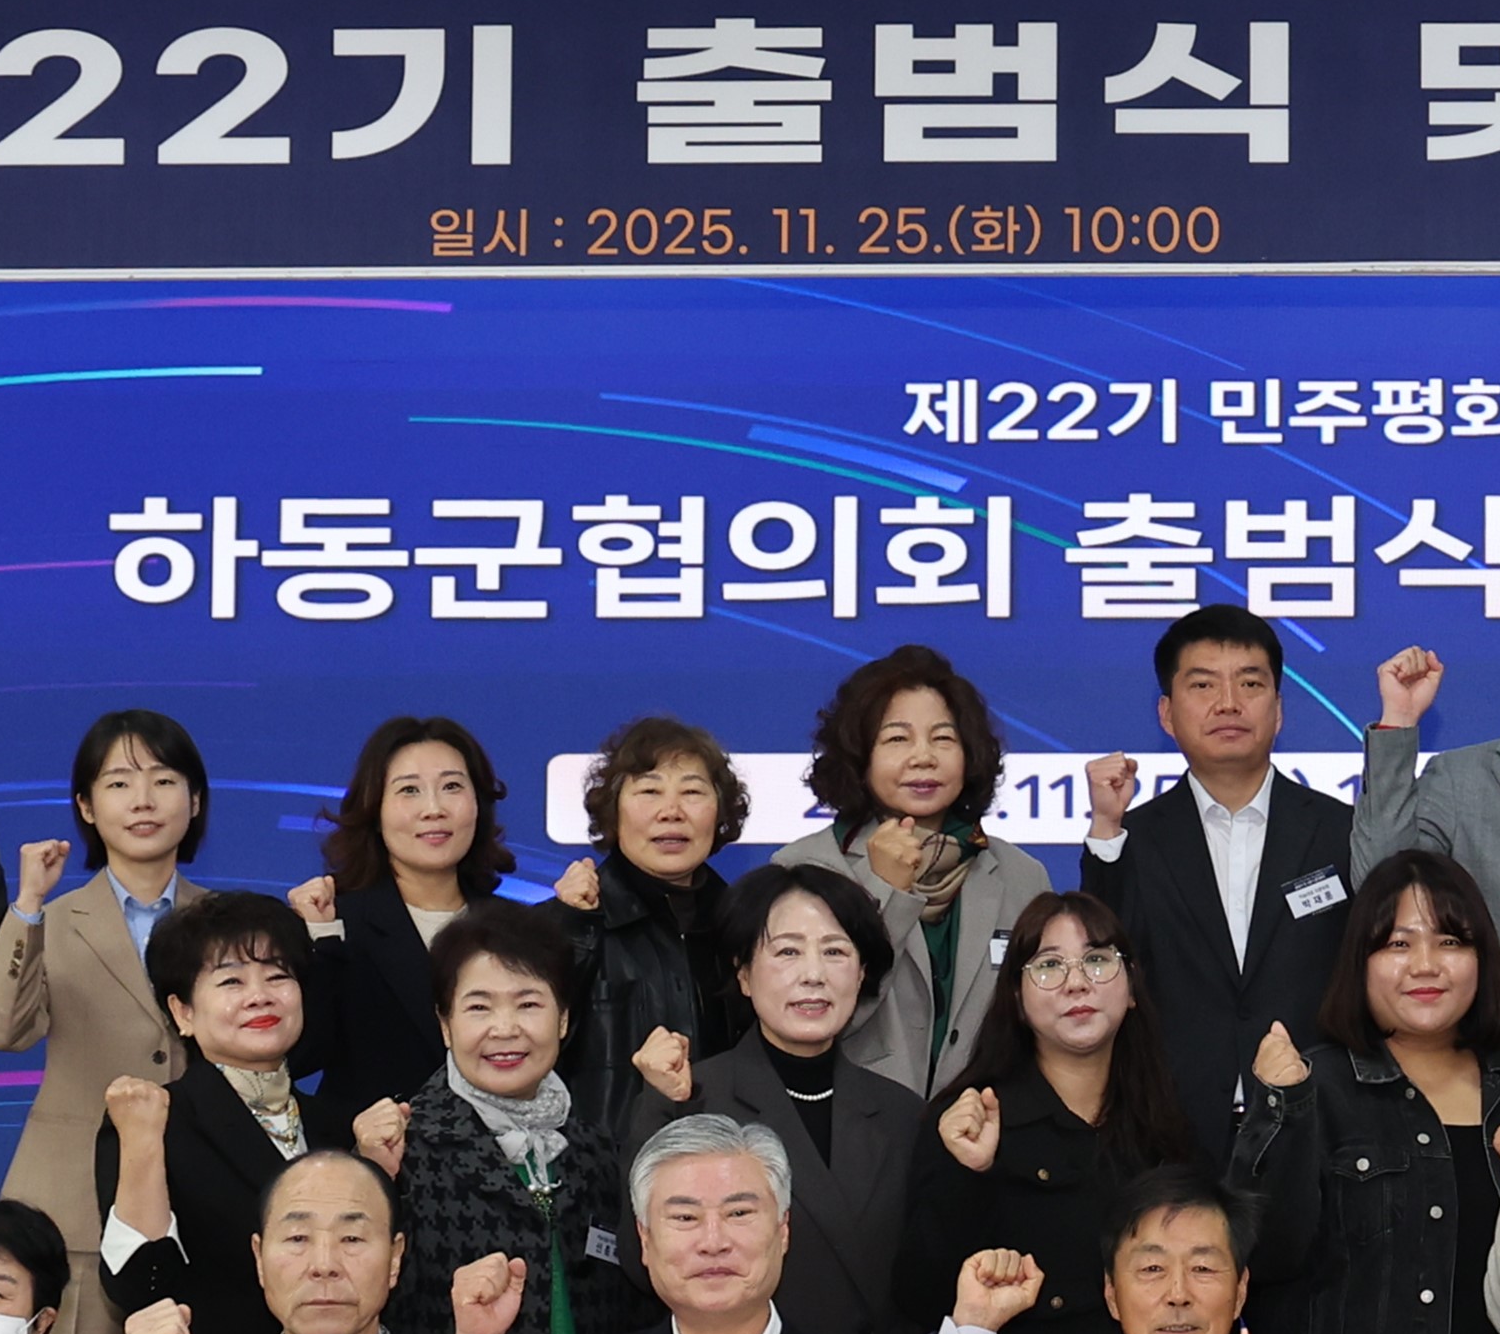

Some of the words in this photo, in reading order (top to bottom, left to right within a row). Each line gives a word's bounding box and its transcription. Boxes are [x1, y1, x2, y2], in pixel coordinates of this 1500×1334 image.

[637, 18, 1291, 166] 출범식
[430, 208, 529, 258] 일시
[587, 208, 750, 256] 2025.
[772, 208, 836, 255] 11.
[858, 205, 1043, 256] 25.(화)
[1064, 206, 1222, 255] 10:00
[903, 378, 1180, 446] 제22기
[108, 493, 1013, 622] 하동군협의회
